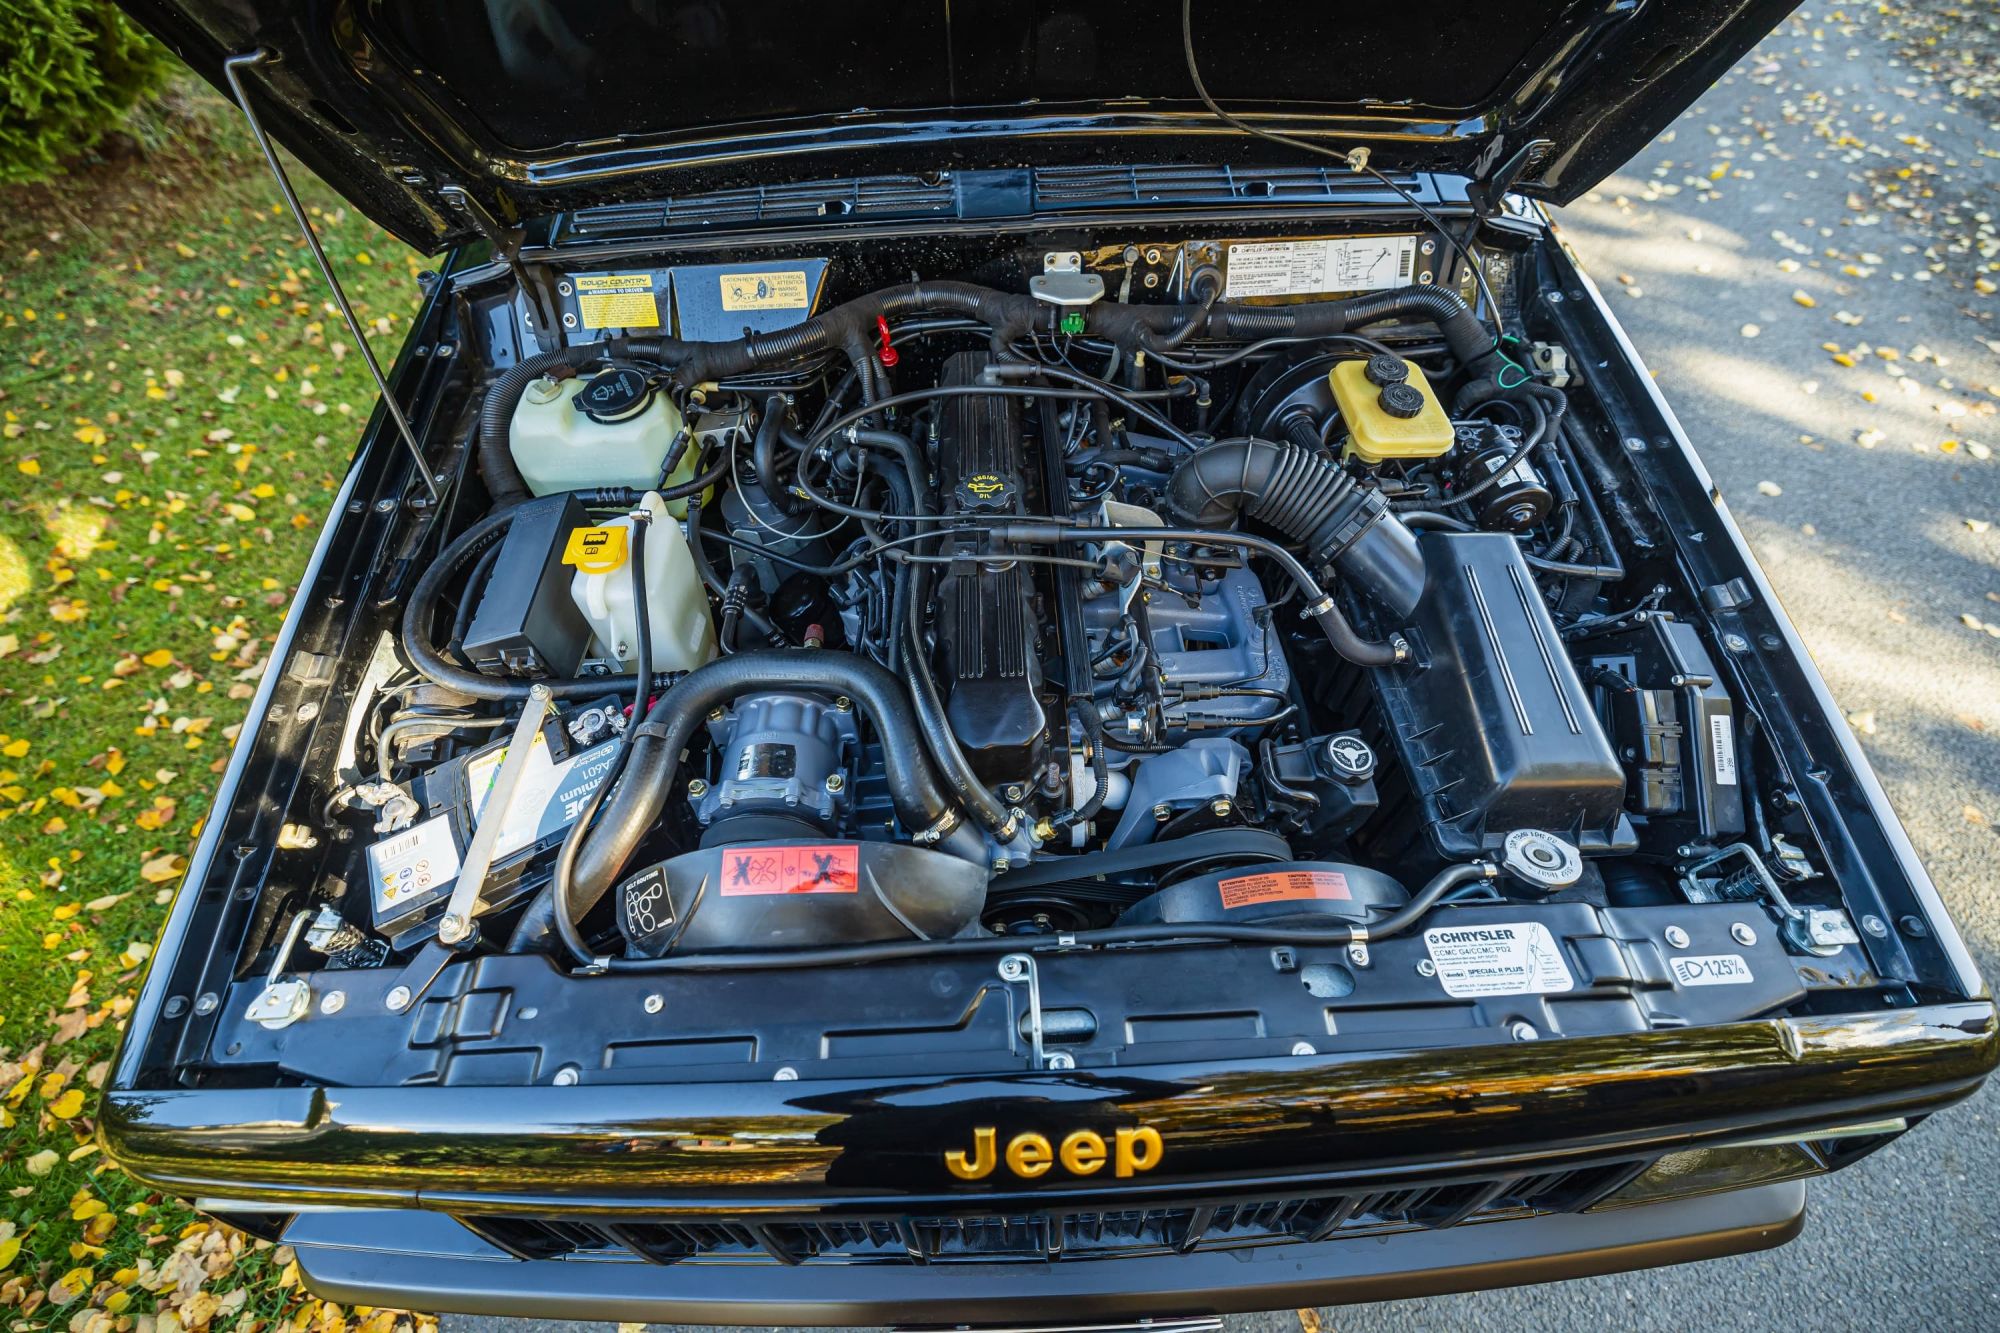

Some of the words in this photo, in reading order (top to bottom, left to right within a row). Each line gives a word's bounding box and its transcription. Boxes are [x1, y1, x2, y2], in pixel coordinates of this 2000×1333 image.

[972, 474, 999, 482] ENGINE
[582, 756, 616, 780] A601
[560, 776, 602, 801] emium
[626, 880, 637, 891] BELT
[636, 870, 659, 885] ROUTING
[1440, 929, 1515, 943] CHRYSLER
[1433, 948, 1458, 957] CCMC
[1458, 946, 1495, 956] G4/CCMC
[1495, 946, 1512, 954] PD2
[1467, 967, 1496, 975] SPECIAL
[1703, 959, 1745, 979] 1,25%
[944, 1126, 1164, 1180] Jeep
